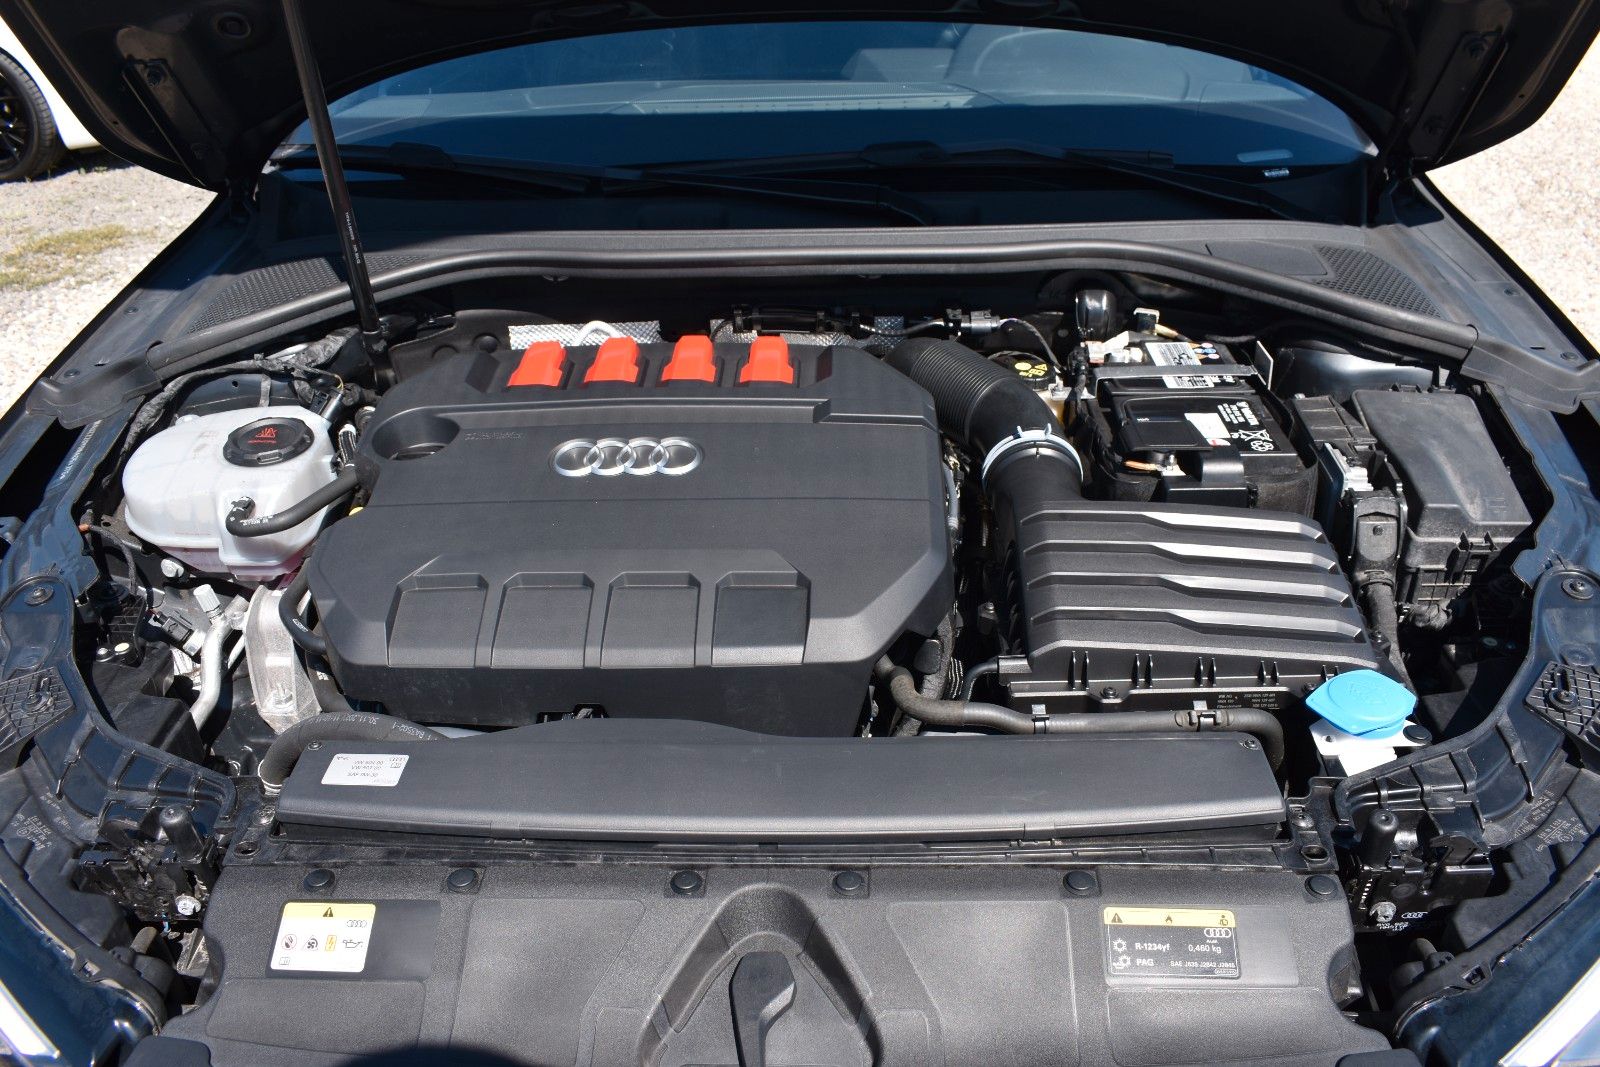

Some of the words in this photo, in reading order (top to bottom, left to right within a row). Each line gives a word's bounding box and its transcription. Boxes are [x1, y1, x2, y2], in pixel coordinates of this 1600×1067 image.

[1134, 942, 1171, 953] R-1234yf
[1211, 945, 1222, 954] kg
[1136, 958, 1155, 967] PAG
